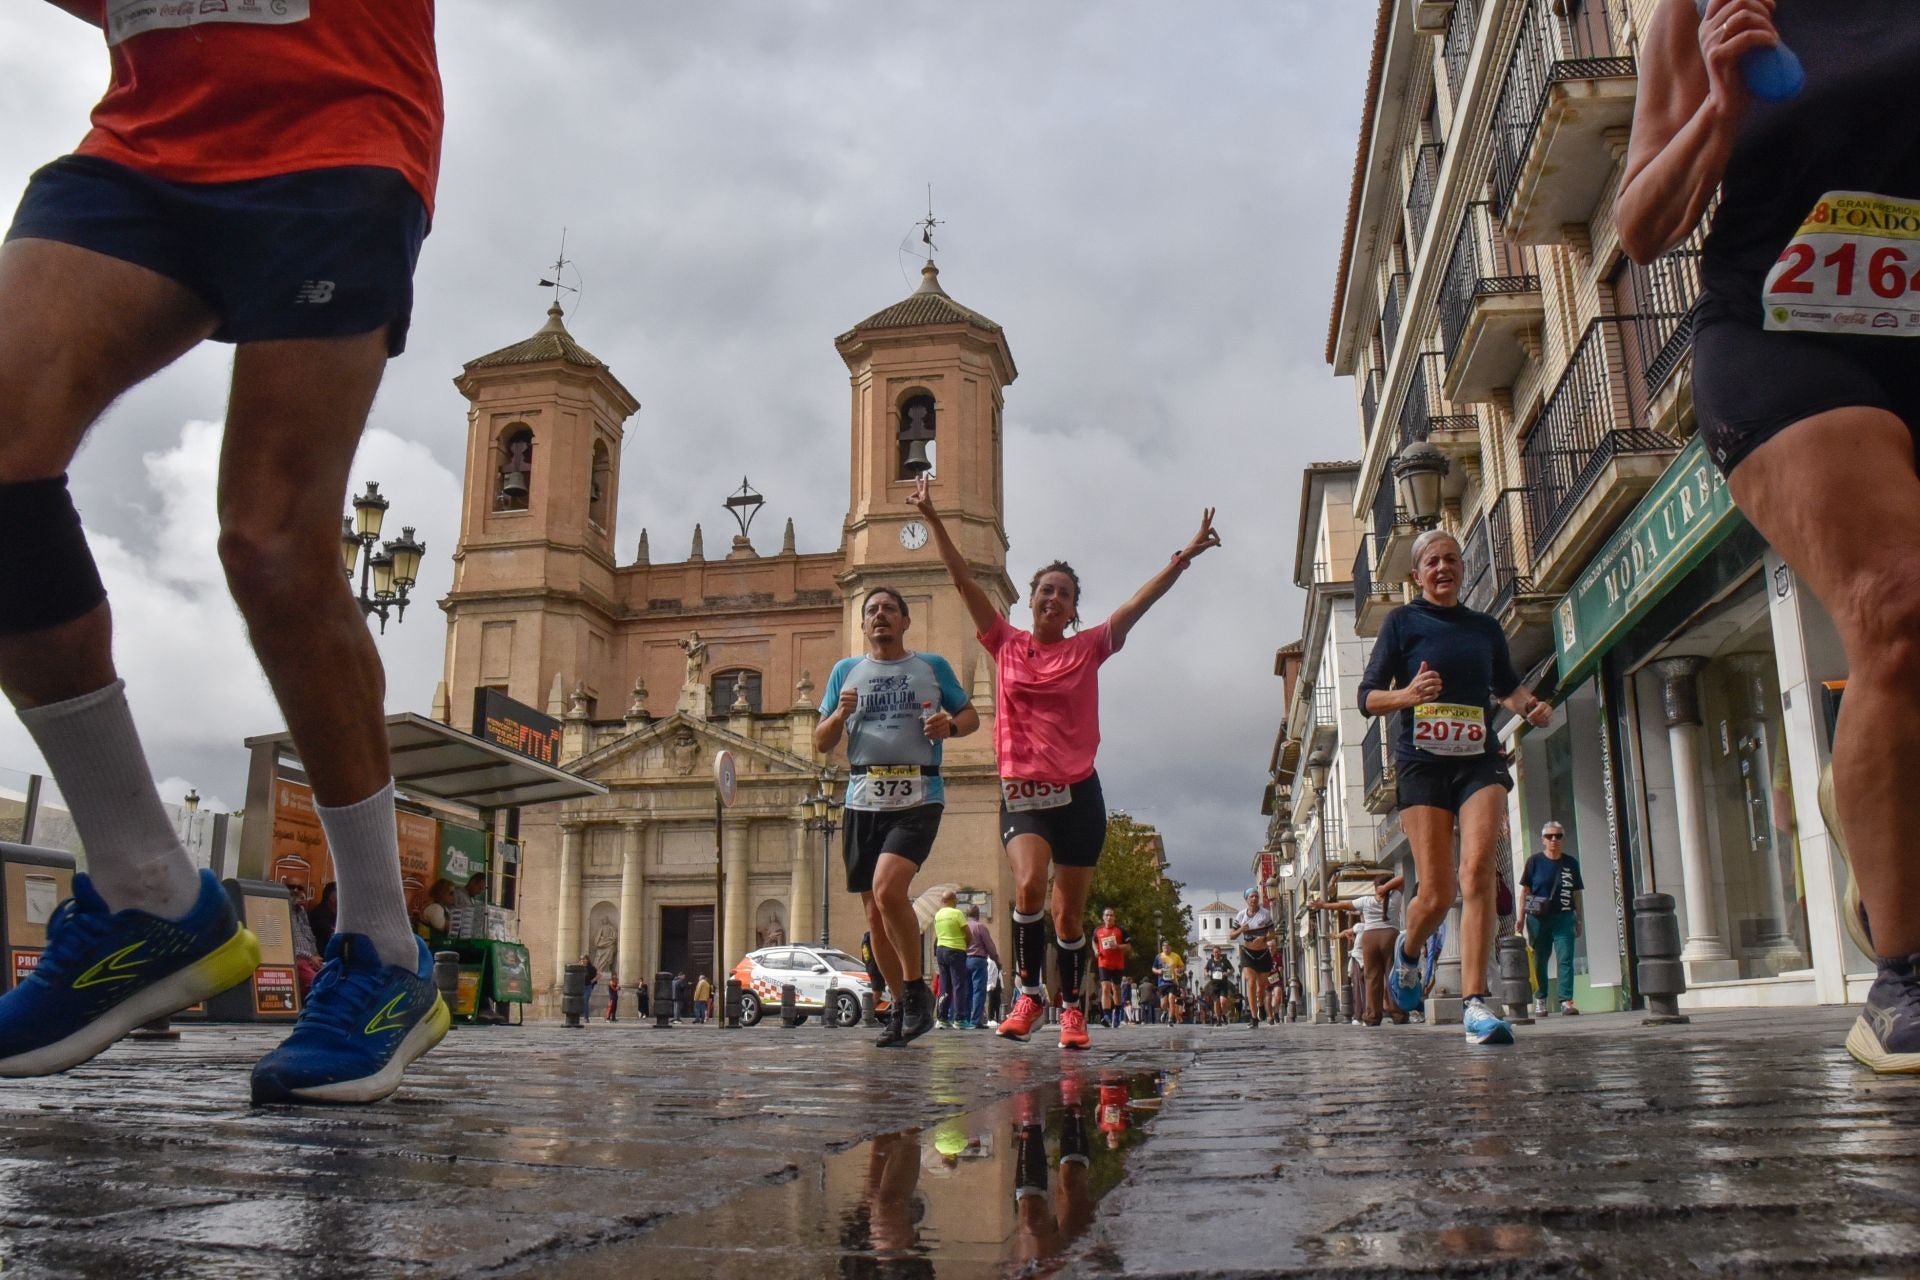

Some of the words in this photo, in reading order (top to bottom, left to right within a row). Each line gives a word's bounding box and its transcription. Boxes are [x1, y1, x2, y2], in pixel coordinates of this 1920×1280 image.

[1837, 200, 1871, 209] GRAN
[1831, 208, 1920, 232] FONDO
[1605, 527, 1659, 607] MODA
[1663, 464, 1726, 540] URBA
[860, 690, 916, 707] TRIATLON
[1415, 721, 1483, 742] 2078
[873, 780, 913, 797] 373
[17, 955, 41, 967] PRO
